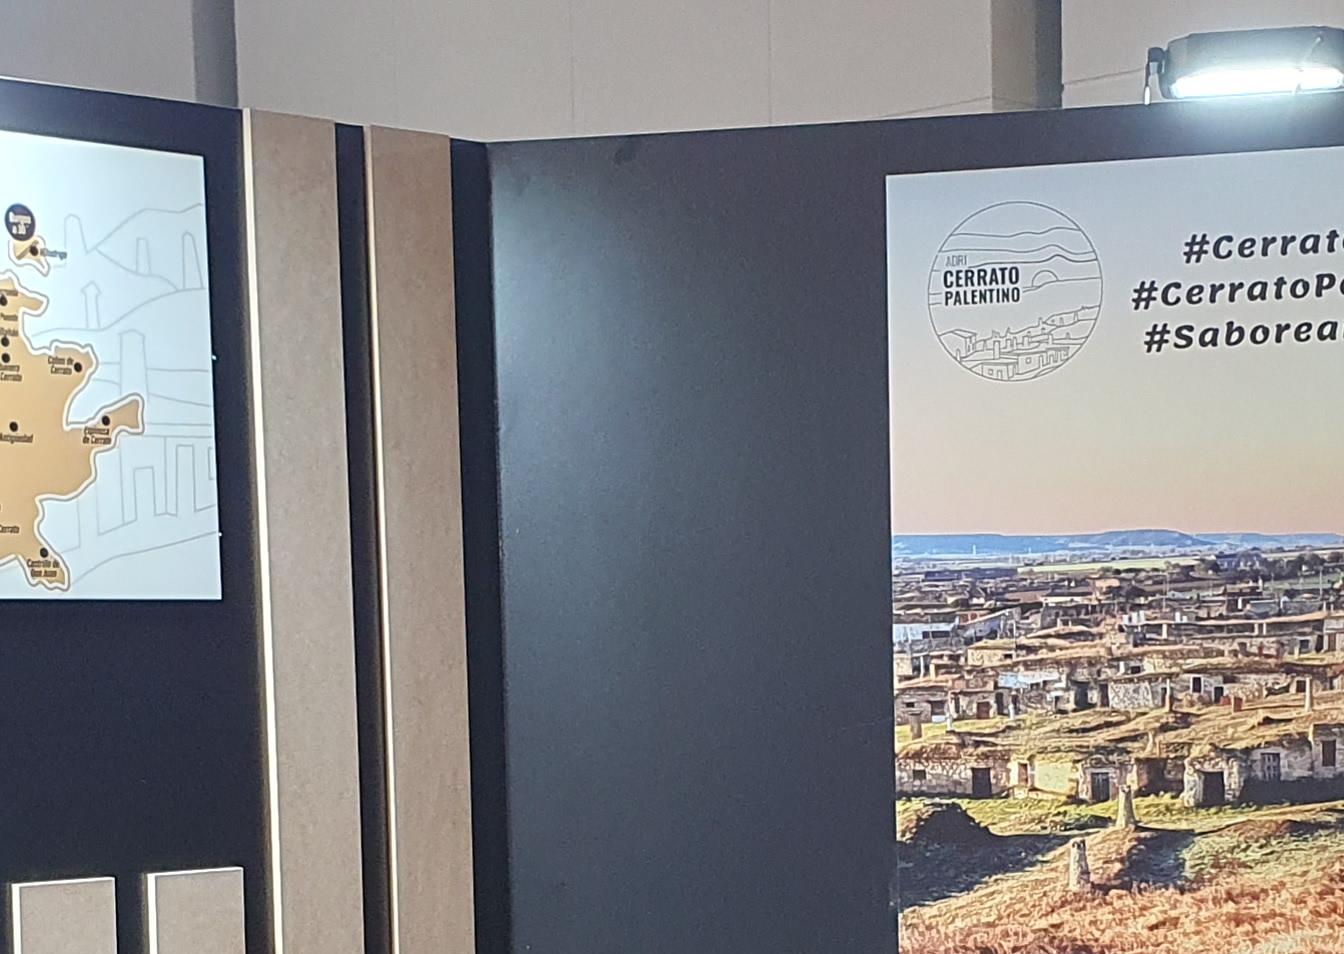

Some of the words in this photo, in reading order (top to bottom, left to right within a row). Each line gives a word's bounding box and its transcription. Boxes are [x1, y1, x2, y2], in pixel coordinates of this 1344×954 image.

[945, 255, 968, 267] ADRI
[943, 267, 1020, 288] CERRATO
[945, 287, 1020, 306] PALENTINO
